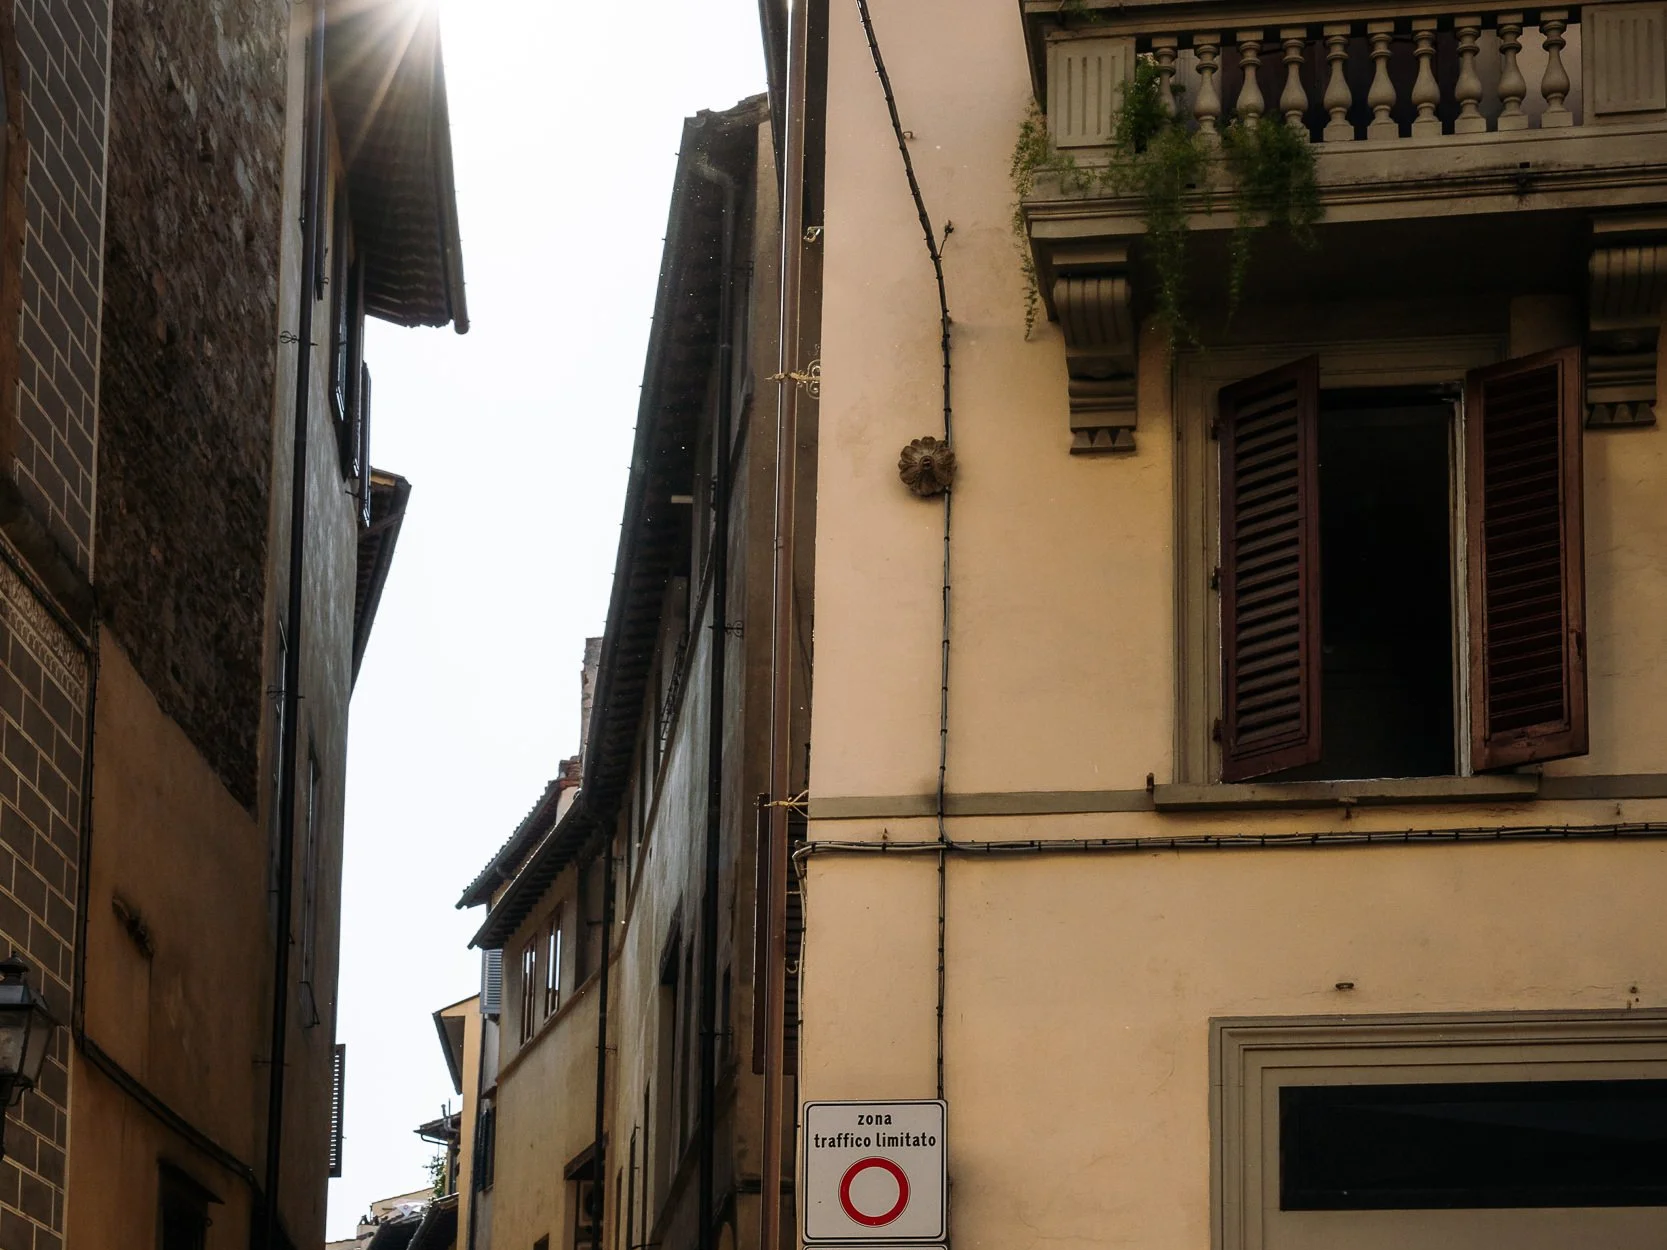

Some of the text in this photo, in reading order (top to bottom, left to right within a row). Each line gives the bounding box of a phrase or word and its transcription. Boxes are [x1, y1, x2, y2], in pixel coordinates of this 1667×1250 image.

[857, 1114, 892, 1125] zona
[814, 1132, 936, 1148] traffico limitato
